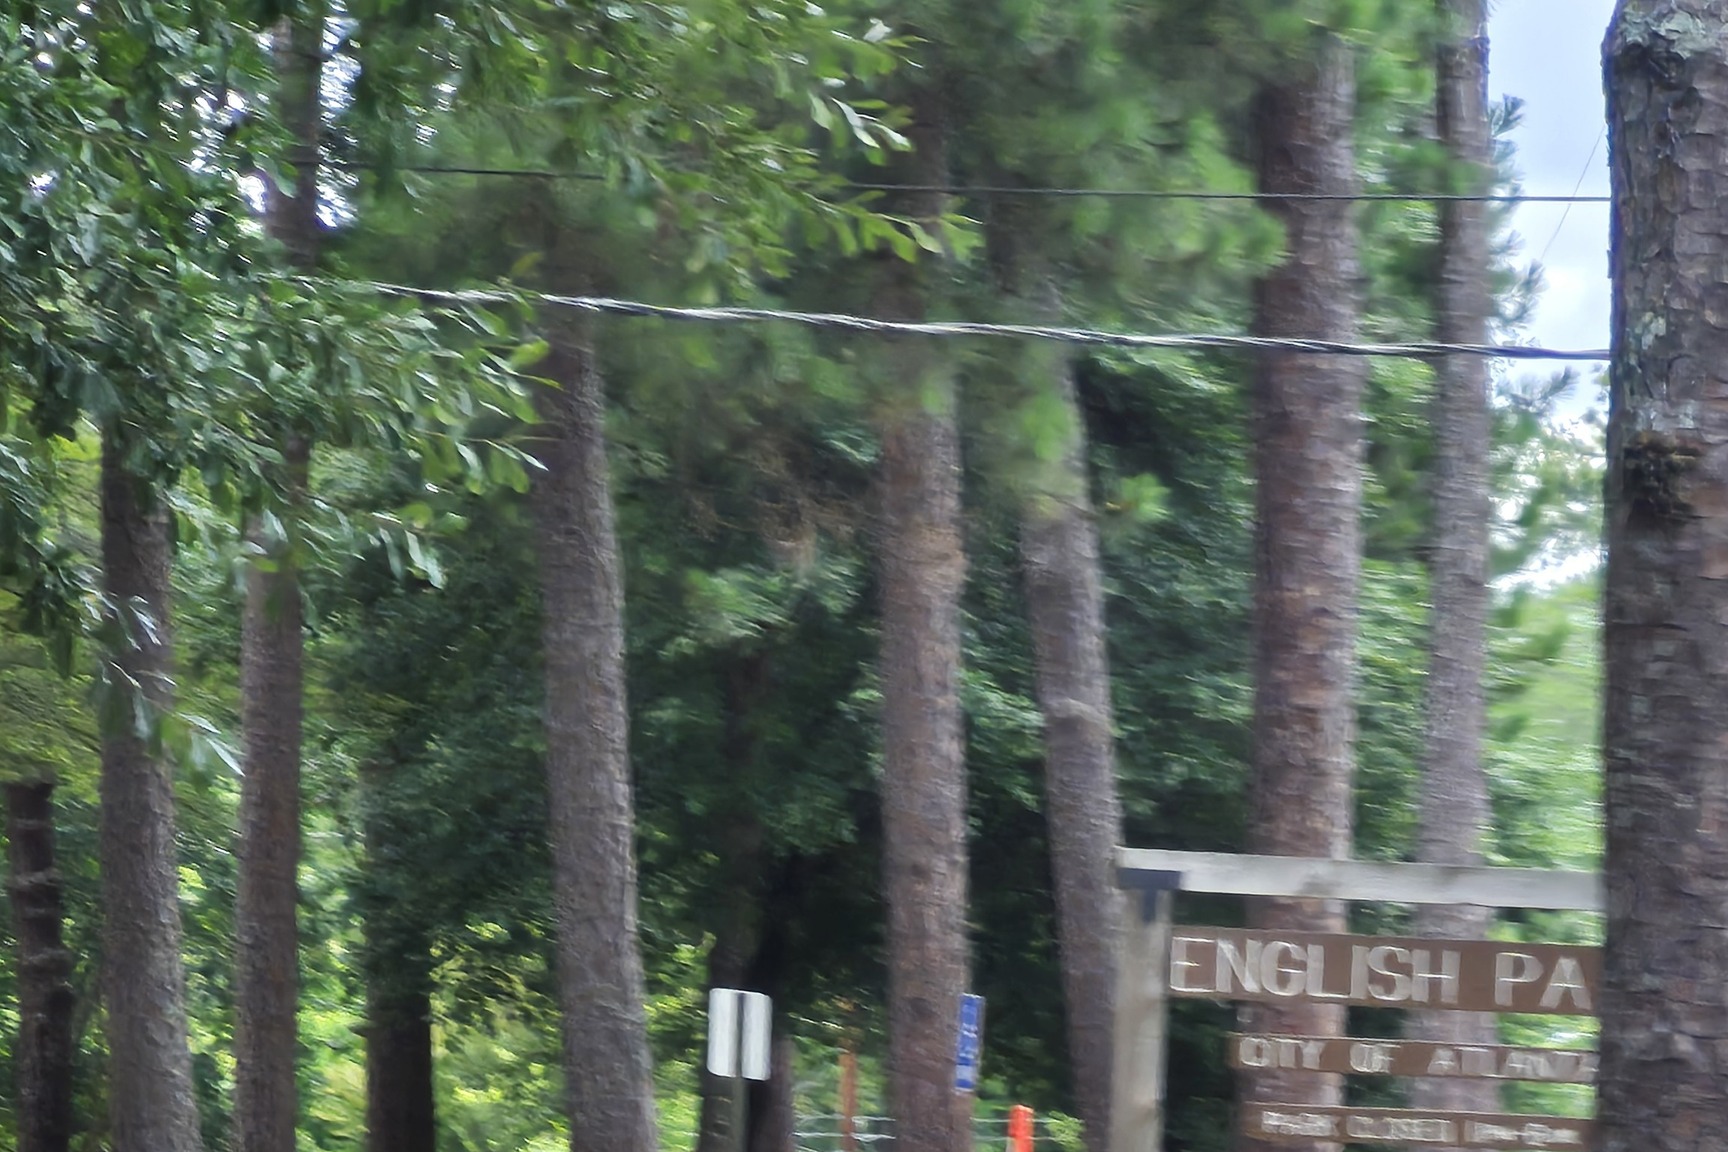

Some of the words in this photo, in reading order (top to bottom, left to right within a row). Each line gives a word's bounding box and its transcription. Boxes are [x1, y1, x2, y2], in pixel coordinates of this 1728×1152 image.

[1170, 936, 1461, 1004] ENGLISH
[1239, 1037, 1324, 1069] CITY
[1349, 1041, 1400, 1073] OF
